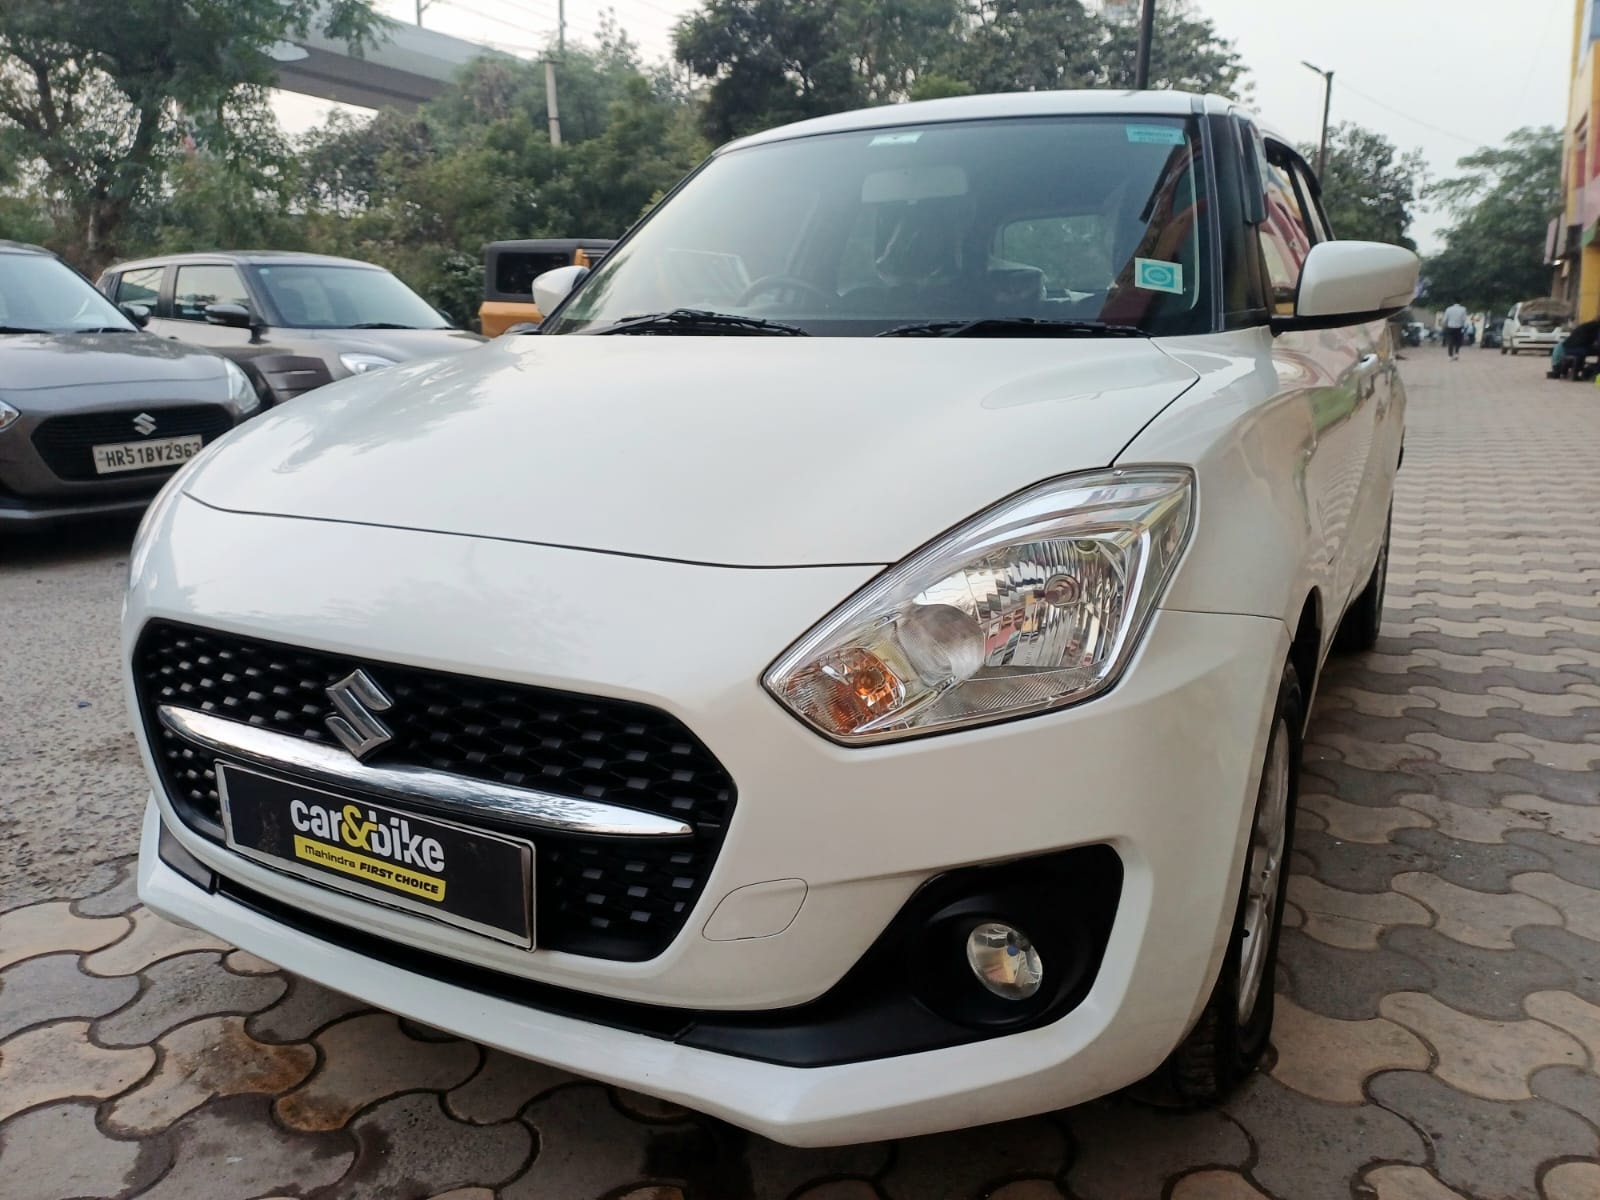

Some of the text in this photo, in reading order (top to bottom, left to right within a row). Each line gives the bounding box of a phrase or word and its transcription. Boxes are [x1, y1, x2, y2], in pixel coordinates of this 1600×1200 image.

[106, 442, 202, 467] HR51BV2963
[290, 799, 444, 873] car&bike
[360, 863, 394, 880] FIRST
[395, 874, 439, 894] CHOICE
